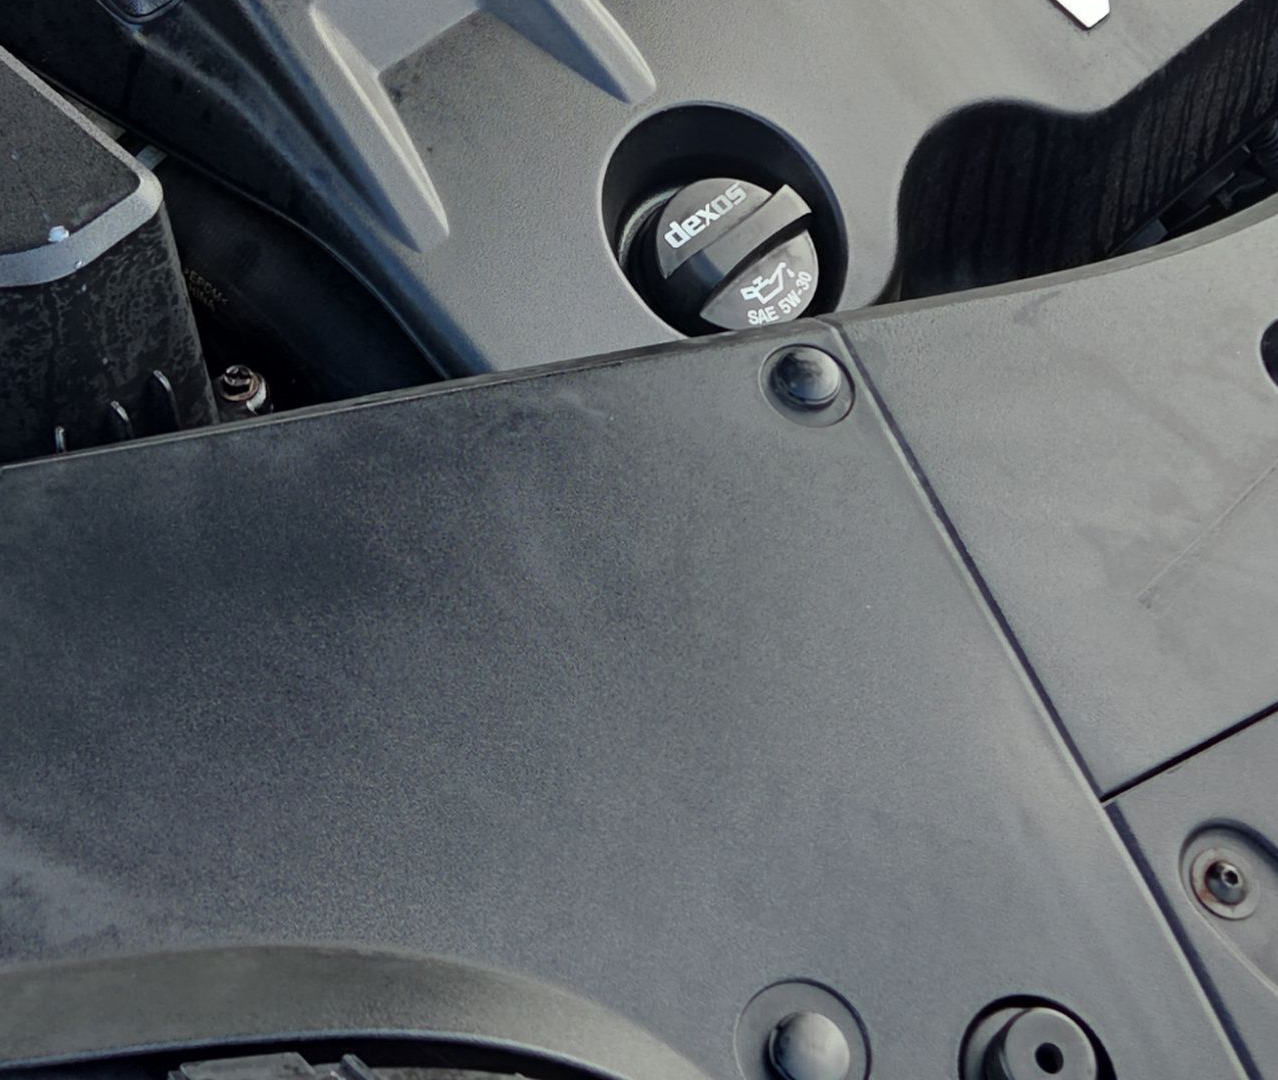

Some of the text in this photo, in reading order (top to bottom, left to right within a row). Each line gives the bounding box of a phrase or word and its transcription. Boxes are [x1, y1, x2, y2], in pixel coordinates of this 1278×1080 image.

[664, 183, 747, 248] dexos
[747, 271, 813, 326] SAE 5W-30
